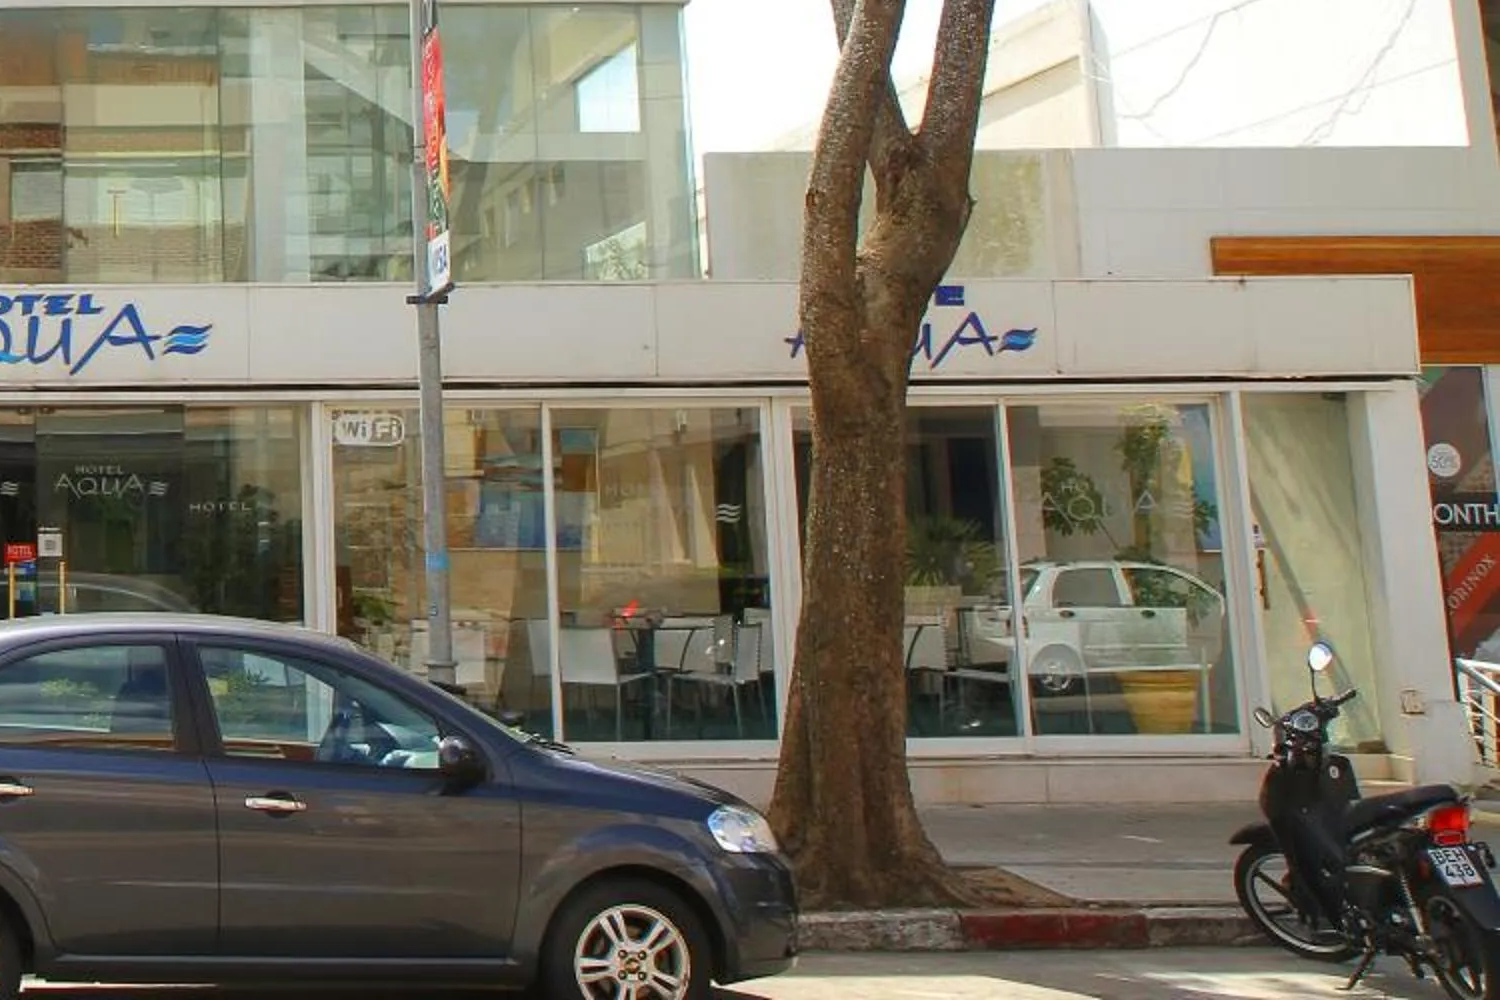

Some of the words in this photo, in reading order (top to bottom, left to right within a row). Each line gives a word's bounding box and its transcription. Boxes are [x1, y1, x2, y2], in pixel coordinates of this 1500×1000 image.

[74, 464, 125, 476] HOTEL
[54, 472, 146, 500] AQUA
[189, 501, 252, 512] HOTEL
[1448, 553, 1496, 614] ORINOX
